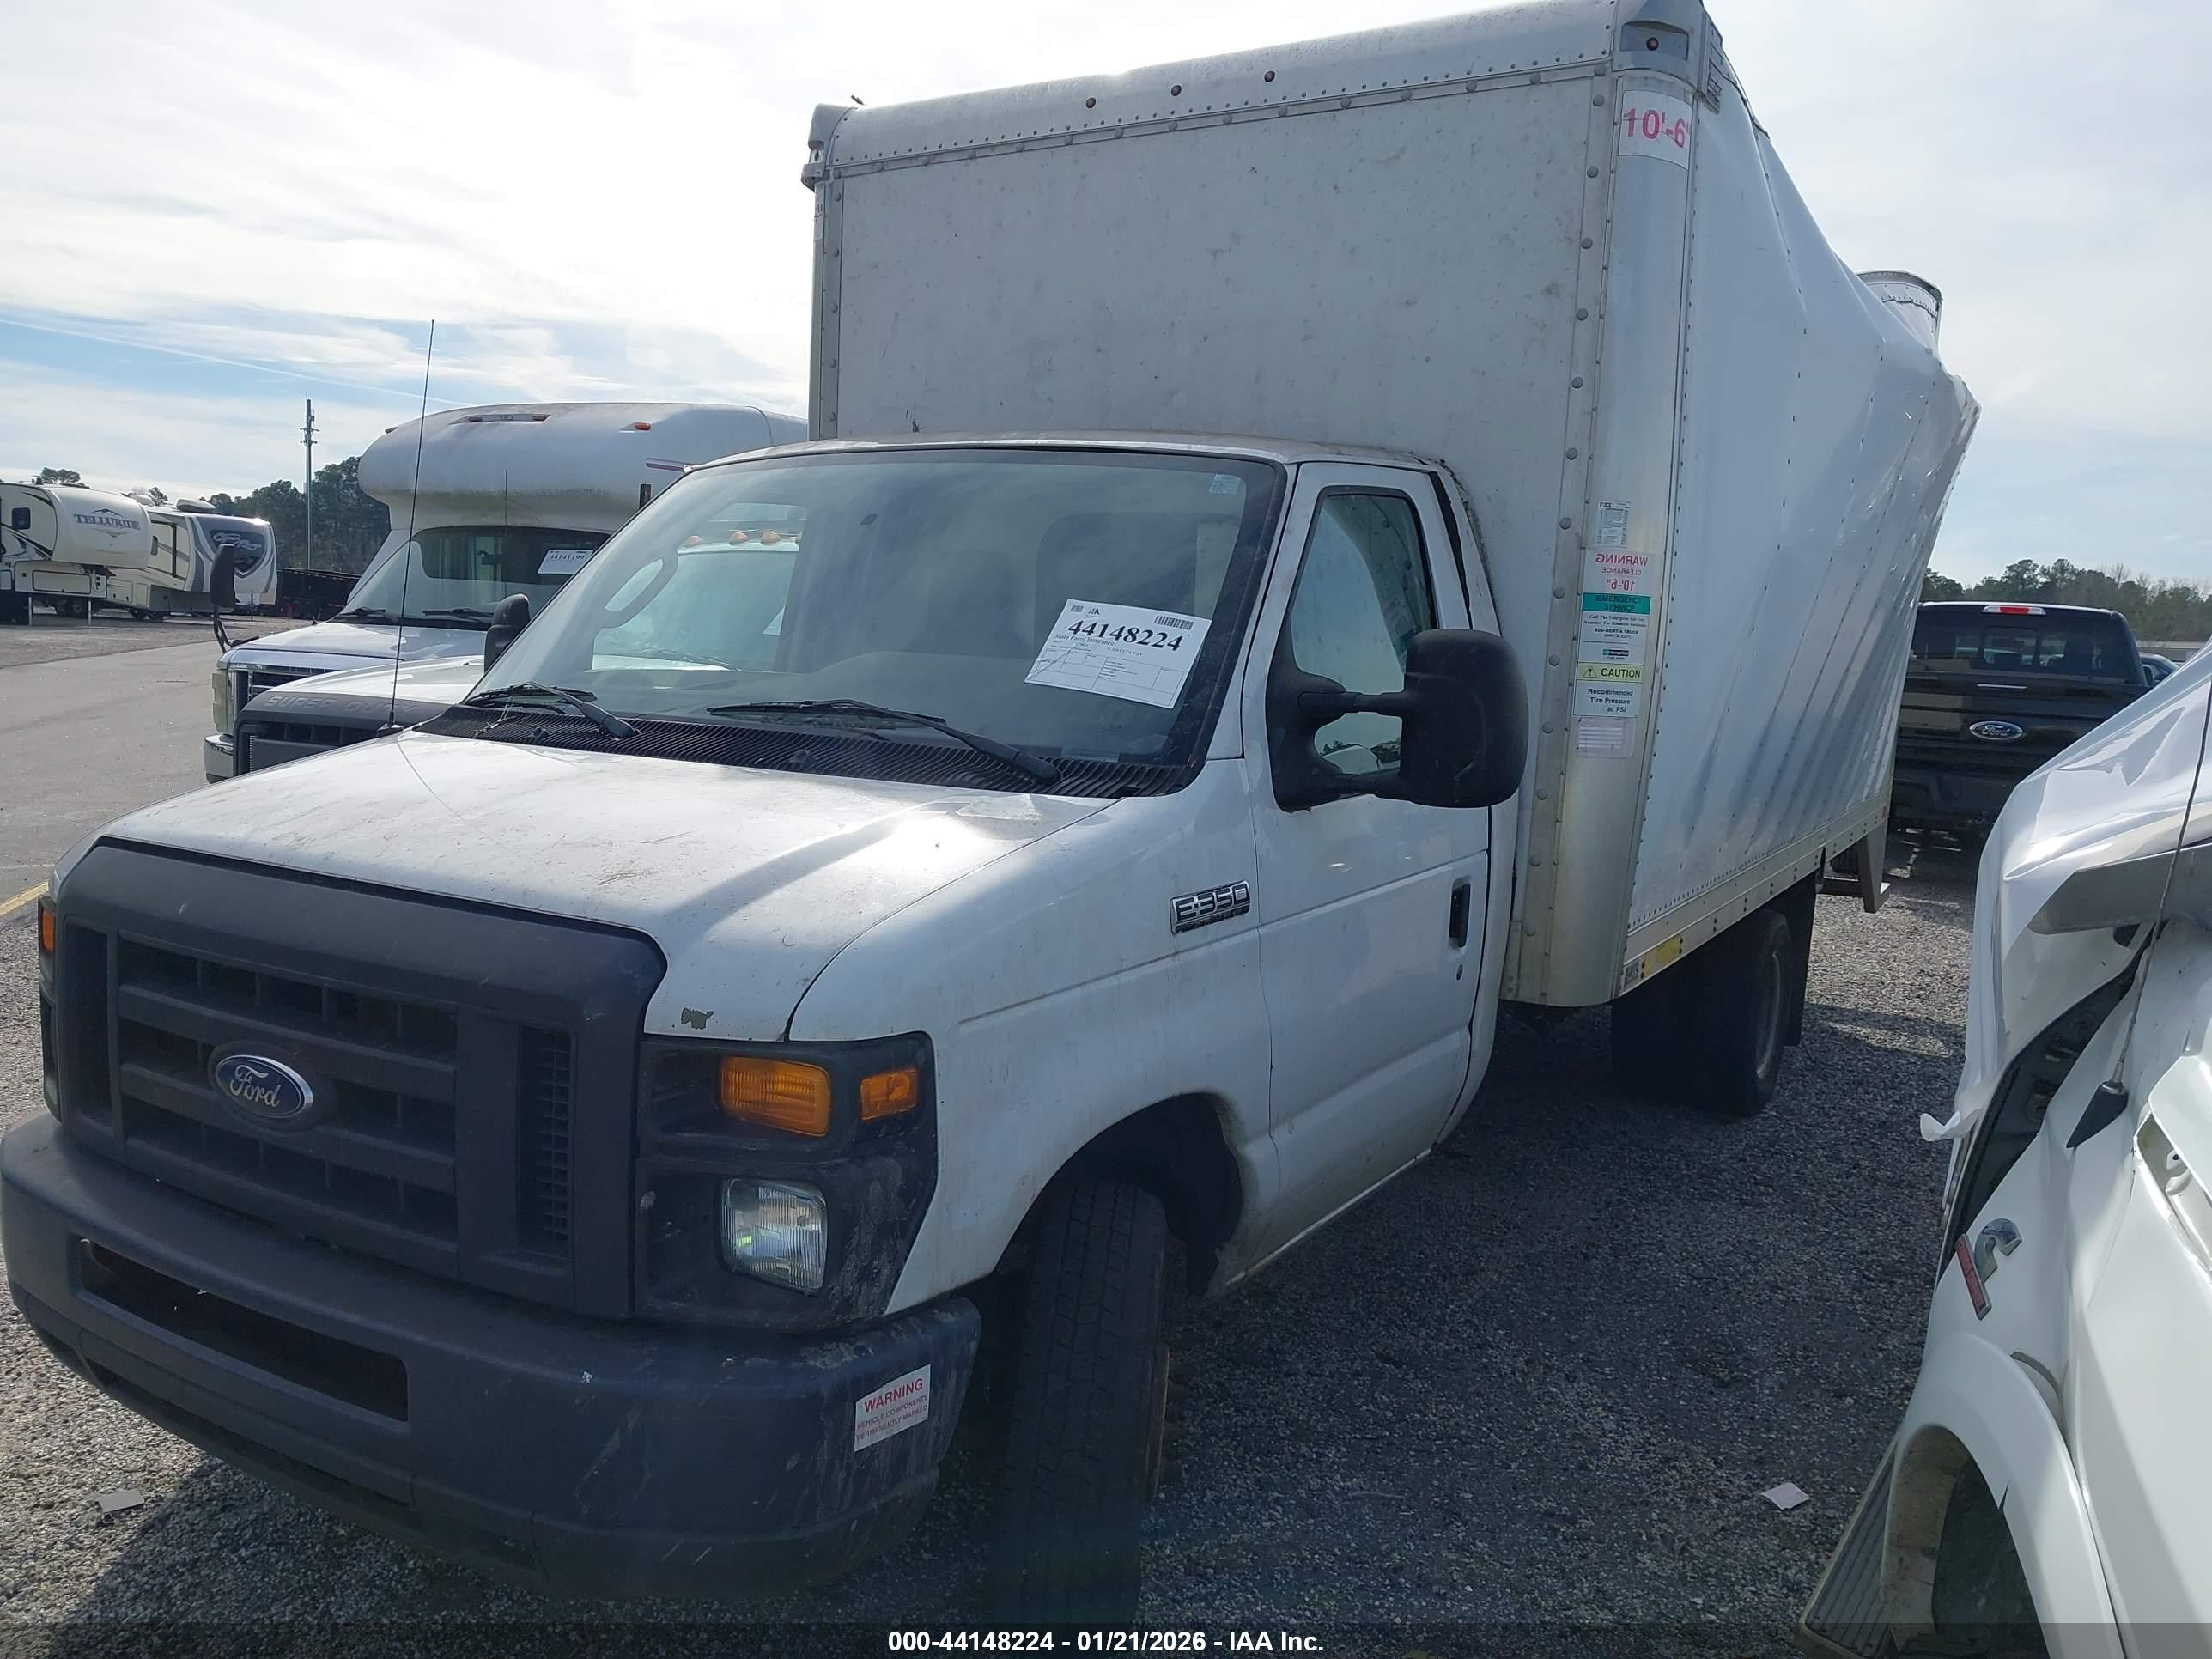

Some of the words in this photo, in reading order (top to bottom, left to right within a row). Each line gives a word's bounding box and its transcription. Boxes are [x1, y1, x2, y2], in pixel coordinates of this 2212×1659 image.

[74, 514, 141, 531] TELLURIDE
[1596, 594, 1643, 605] EMERGENCY
[1604, 603, 1636, 612] SERVICE
[1067, 619, 1183, 652] 44148224
[1601, 667, 1641, 678] CAUTION
[1587, 688, 1634, 696] Recommended
[264, 695, 338, 709] SUPER
[1982, 724, 2011, 736] Ford
[1174, 882, 1250, 921] E-350
[229, 1064, 282, 1108] Ford
[864, 1377, 924, 1413] WARNING
